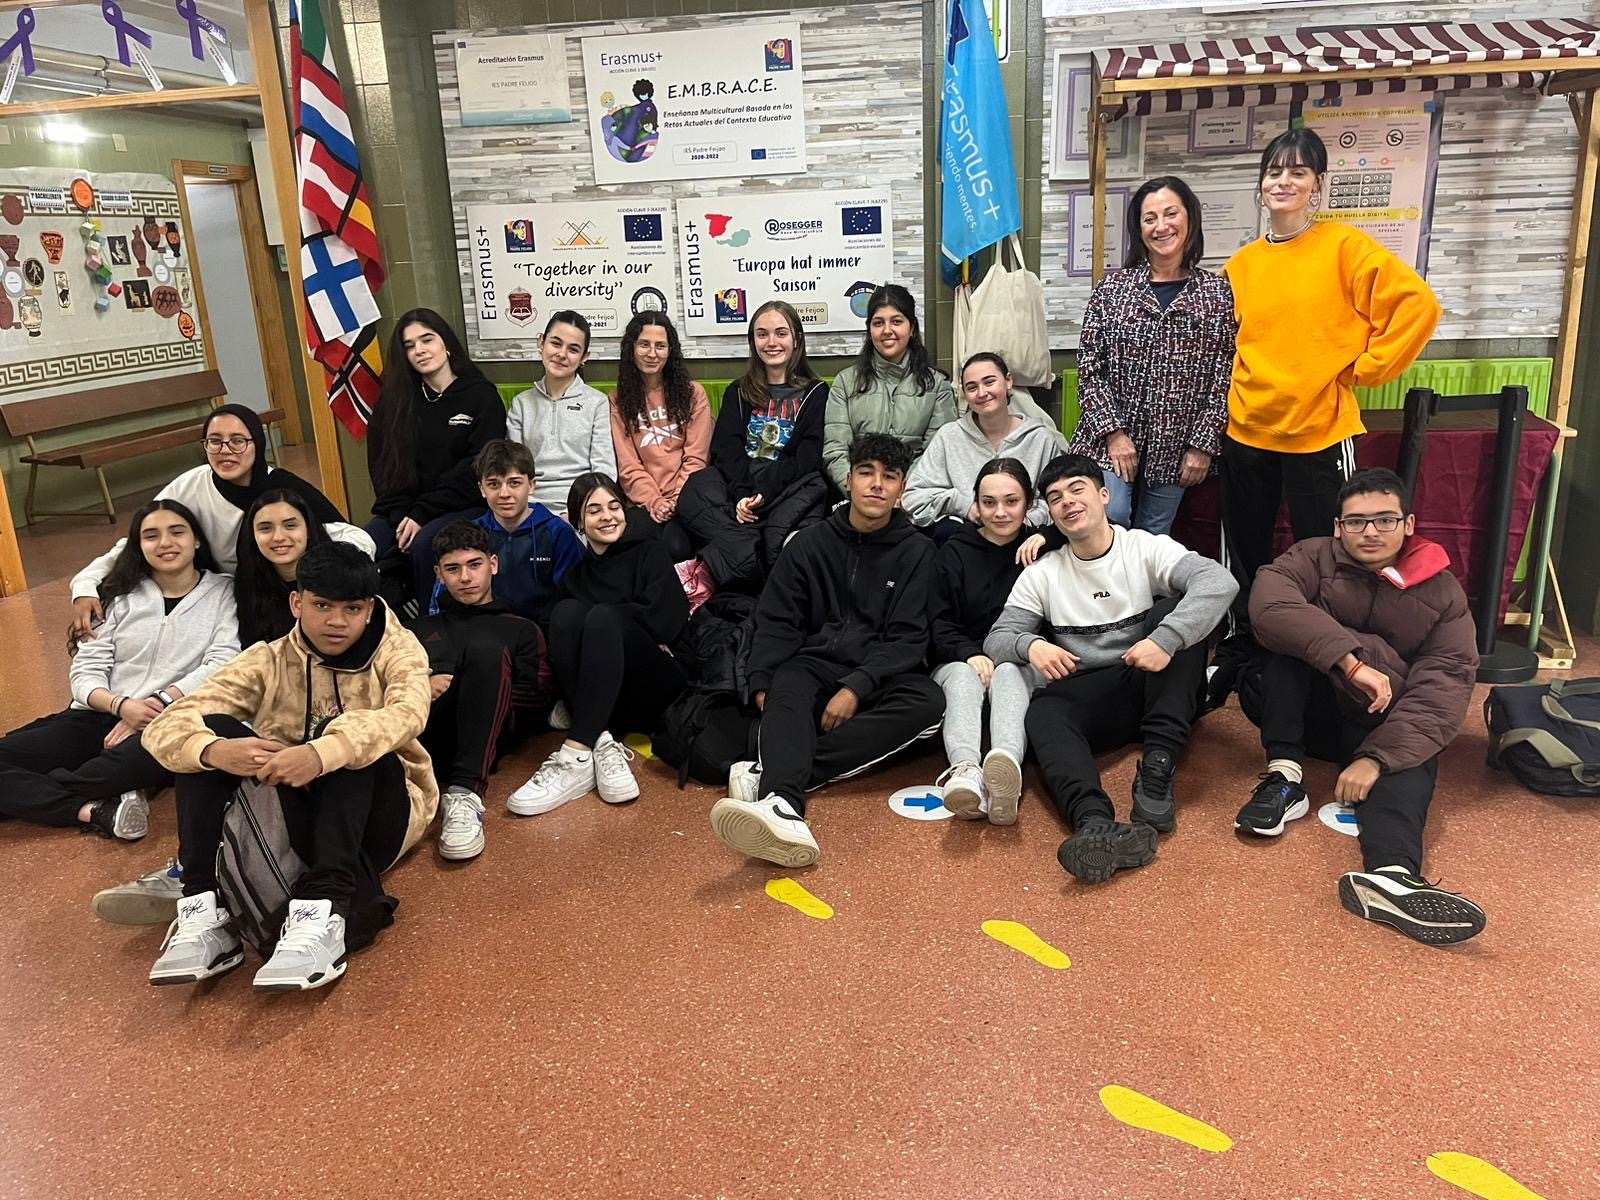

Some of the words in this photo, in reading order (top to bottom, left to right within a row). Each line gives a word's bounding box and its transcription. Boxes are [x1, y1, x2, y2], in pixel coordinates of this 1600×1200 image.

[478, 56, 517, 64] Acreditación
[600, 51, 663, 66] Erasmus+
[668, 78, 777, 99] E.M.B.R.A.C.E.
[663, 110, 699, 118] Enseñanza
[700, 105, 745, 116] Multicultural
[746, 104, 770, 113] Basada
[783, 102, 793, 110] los
[664, 120, 683, 128] Retos
[684, 118, 713, 127] Actuales
[714, 117, 725, 126] del
[727, 115, 757, 125] Contexto
[758, 114, 792, 123] Educativo
[957, 183, 978, 233] mentes.
[764, 219, 823, 236] ROSEGGER
[602, 259, 618, 275] in
[624, 263, 654, 275] our
[685, 220, 705, 319] Erasmus+
[791, 255, 813, 270] hat
[818, 255, 861, 269] immer
[476, 225, 498, 320] Erasmus+
[597, 313, 615, 321] Feijoo
[806, 306, 825, 315] Feijoo
[1092, 591, 1111, 600] FILA
